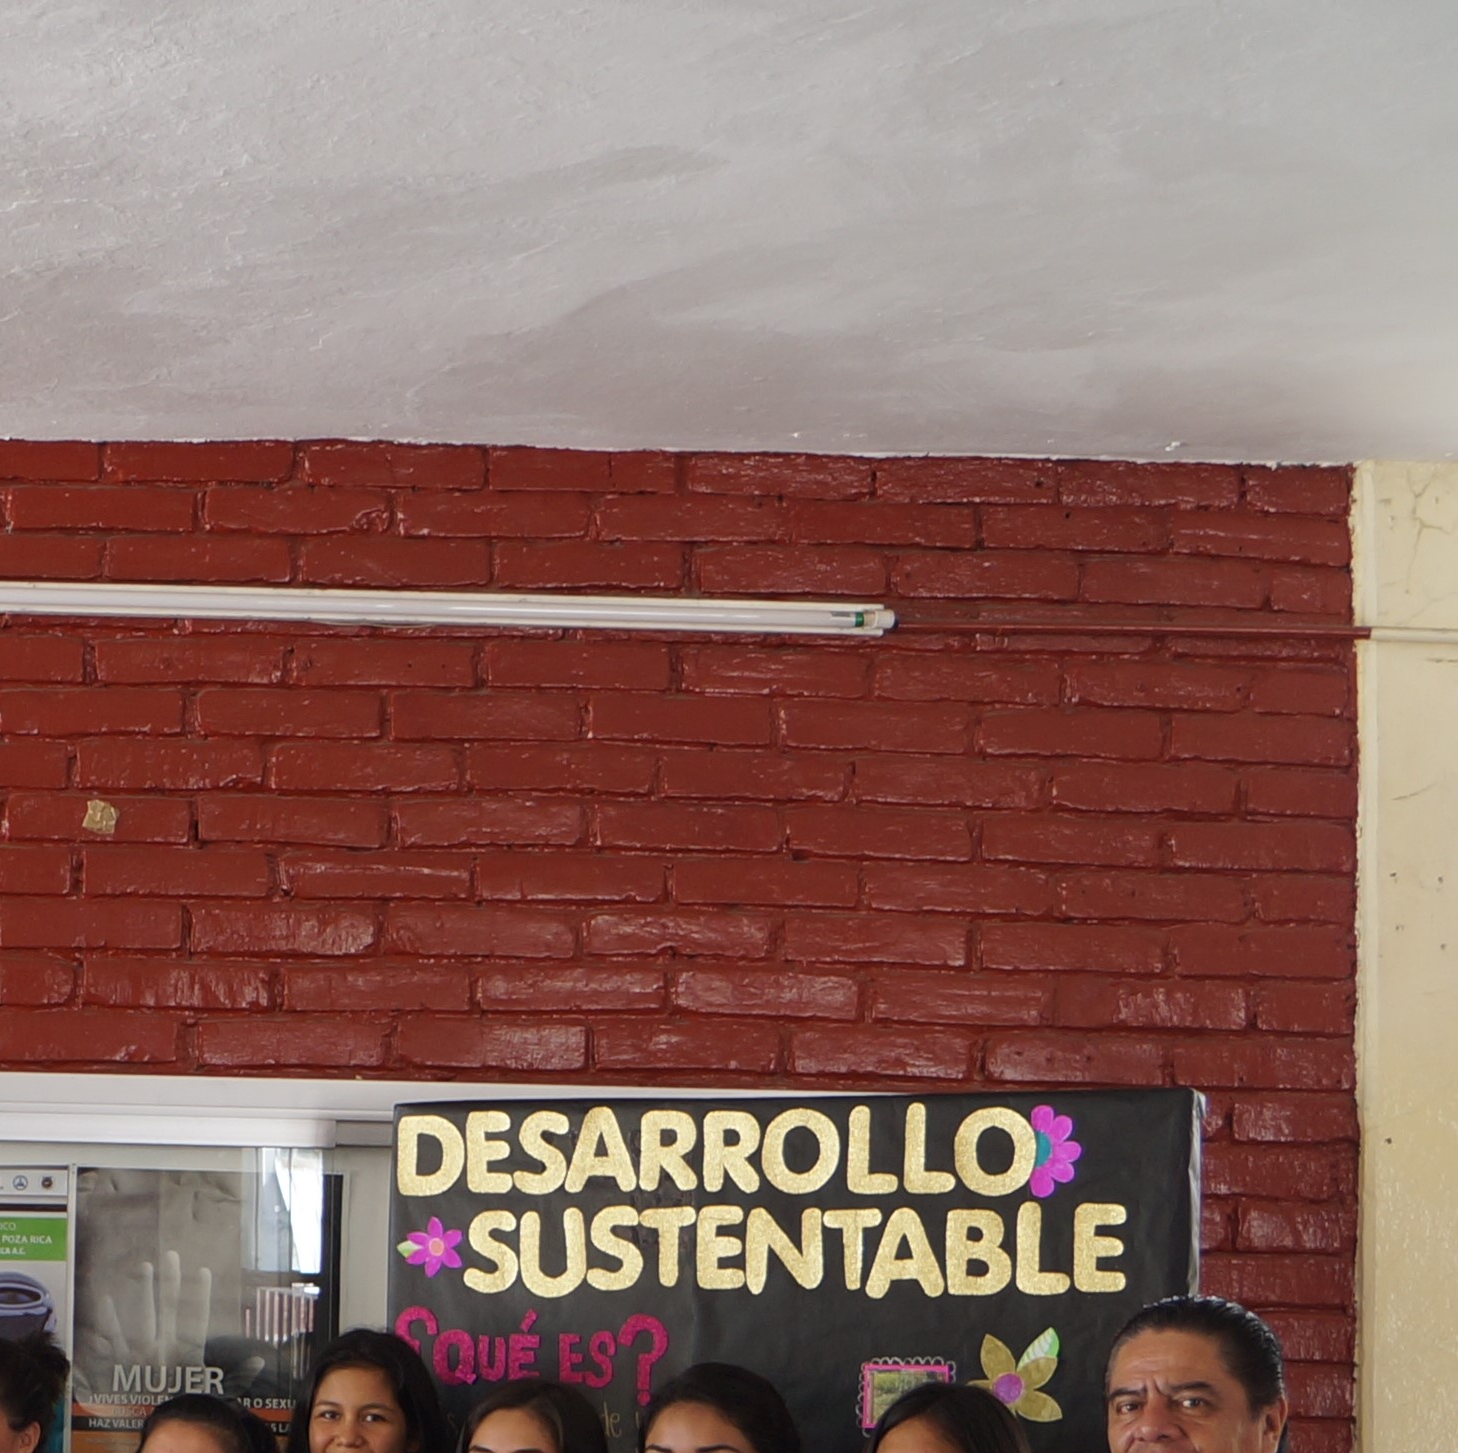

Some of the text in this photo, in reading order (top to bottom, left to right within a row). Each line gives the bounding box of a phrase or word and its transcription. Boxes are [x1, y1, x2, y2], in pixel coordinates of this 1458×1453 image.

[397, 1103, 1037, 1197] DESARROLLO
[2, 1235, 27, 1245] POZA
[30, 1236, 52, 1245] RICA
[464, 1200, 1128, 1300] SUSTENTABLE
[558, 1313, 670, 1407] ES?
[112, 1364, 224, 1395] MUJER
[253, 1397, 263, 1409] O
[88, 1418, 111, 1428] HAZ
[112, 1419, 144, 1429] VALER
